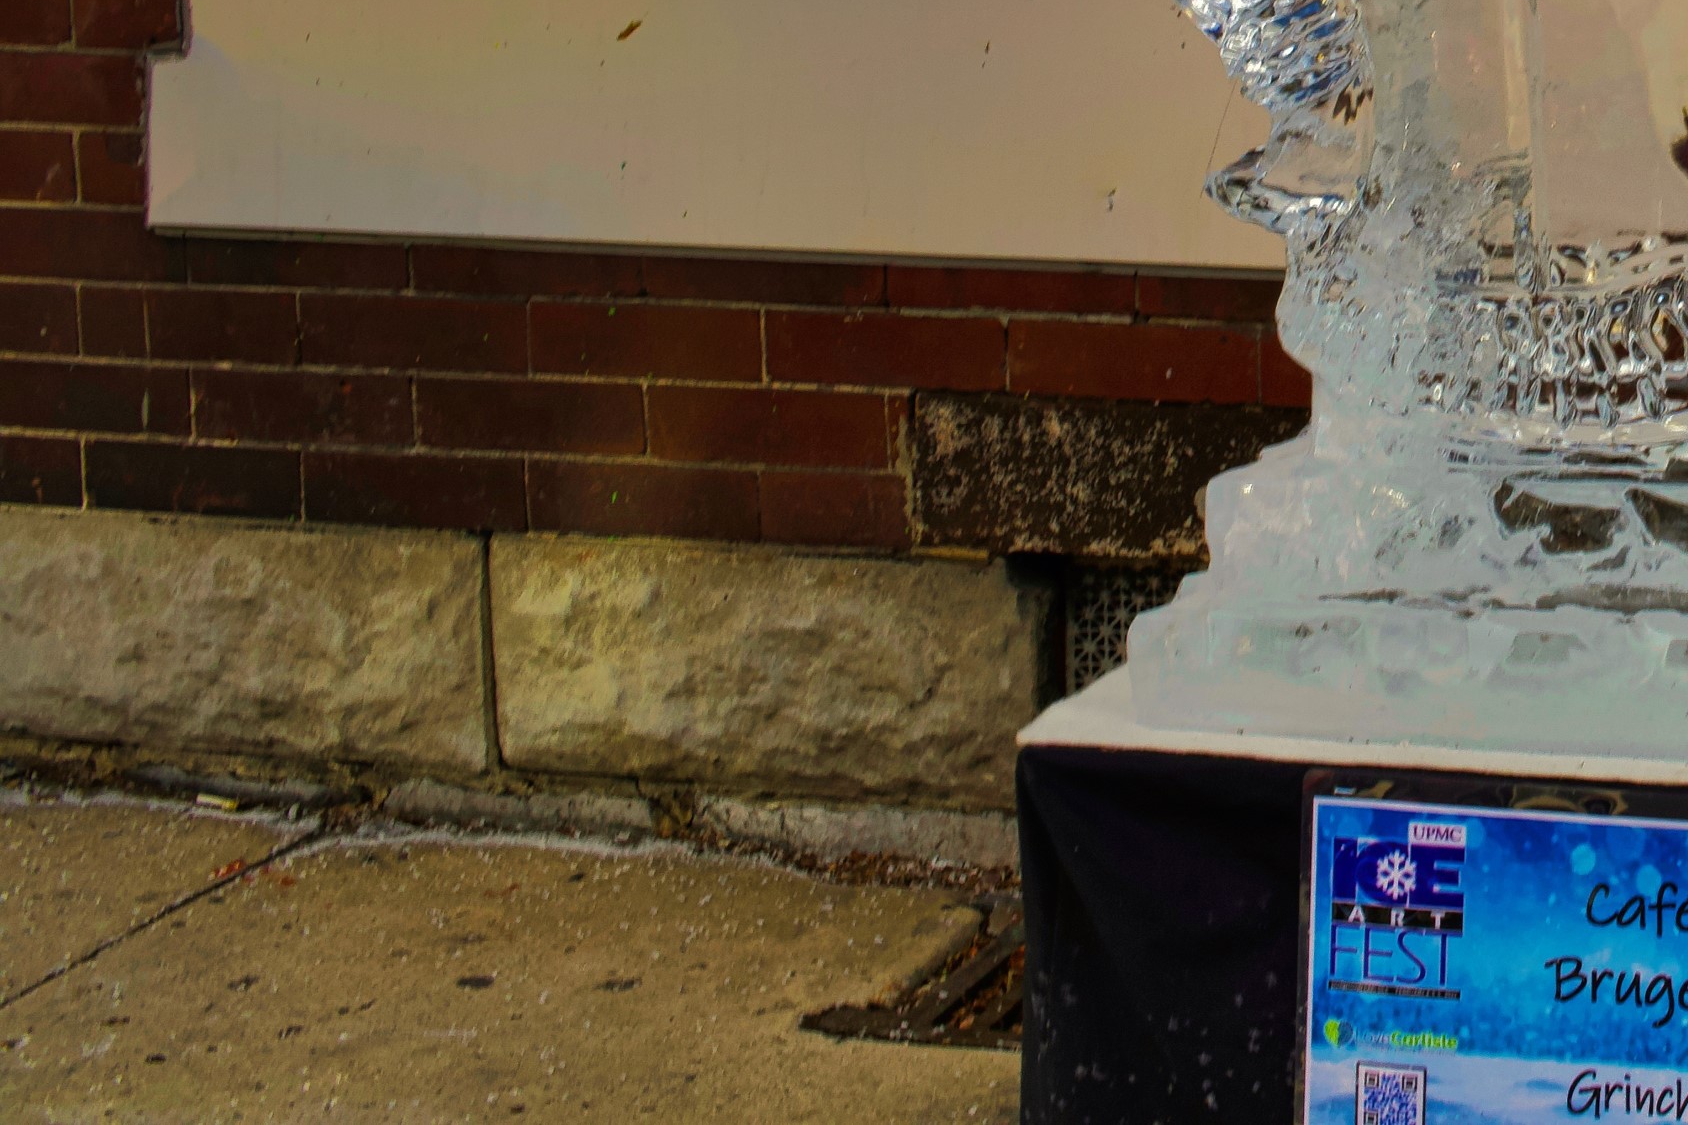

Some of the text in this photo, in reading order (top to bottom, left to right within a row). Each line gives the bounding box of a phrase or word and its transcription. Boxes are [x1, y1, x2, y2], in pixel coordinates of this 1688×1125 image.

[1413, 826, 1461, 842] UPMC
[1333, 837, 1464, 907] ICE
[1347, 905, 1446, 929] ART
[1330, 924, 1463, 986] FEST
